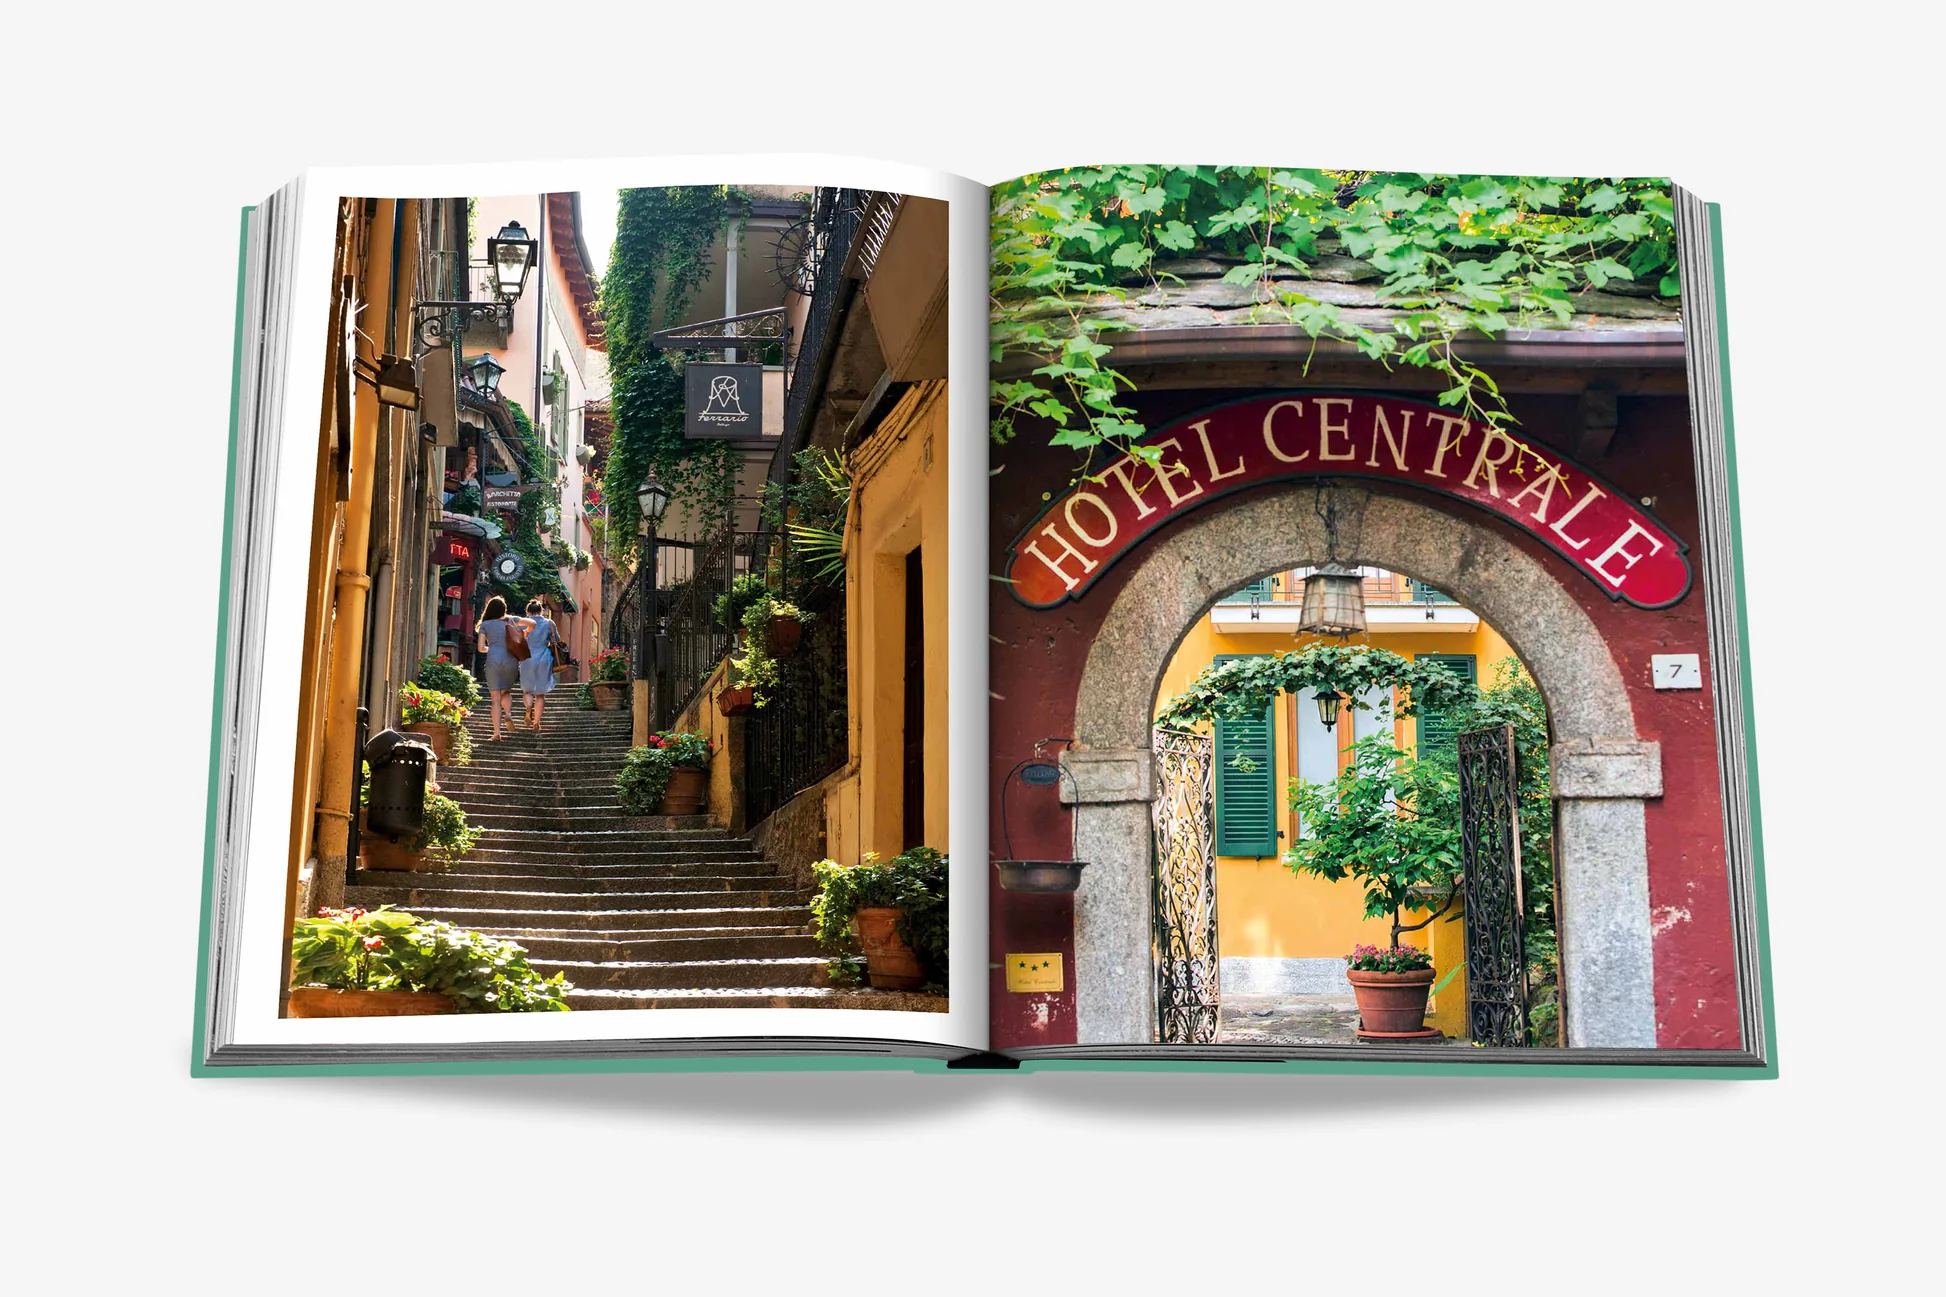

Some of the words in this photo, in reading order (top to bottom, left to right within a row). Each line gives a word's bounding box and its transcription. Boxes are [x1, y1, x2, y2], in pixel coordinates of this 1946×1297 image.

[697, 413, 750, 422] Ferrario
[1023, 418, 1246, 592] HOTEL
[1262, 397, 1664, 588] CENTRALE
[1669, 664, 1683, 678] 7
